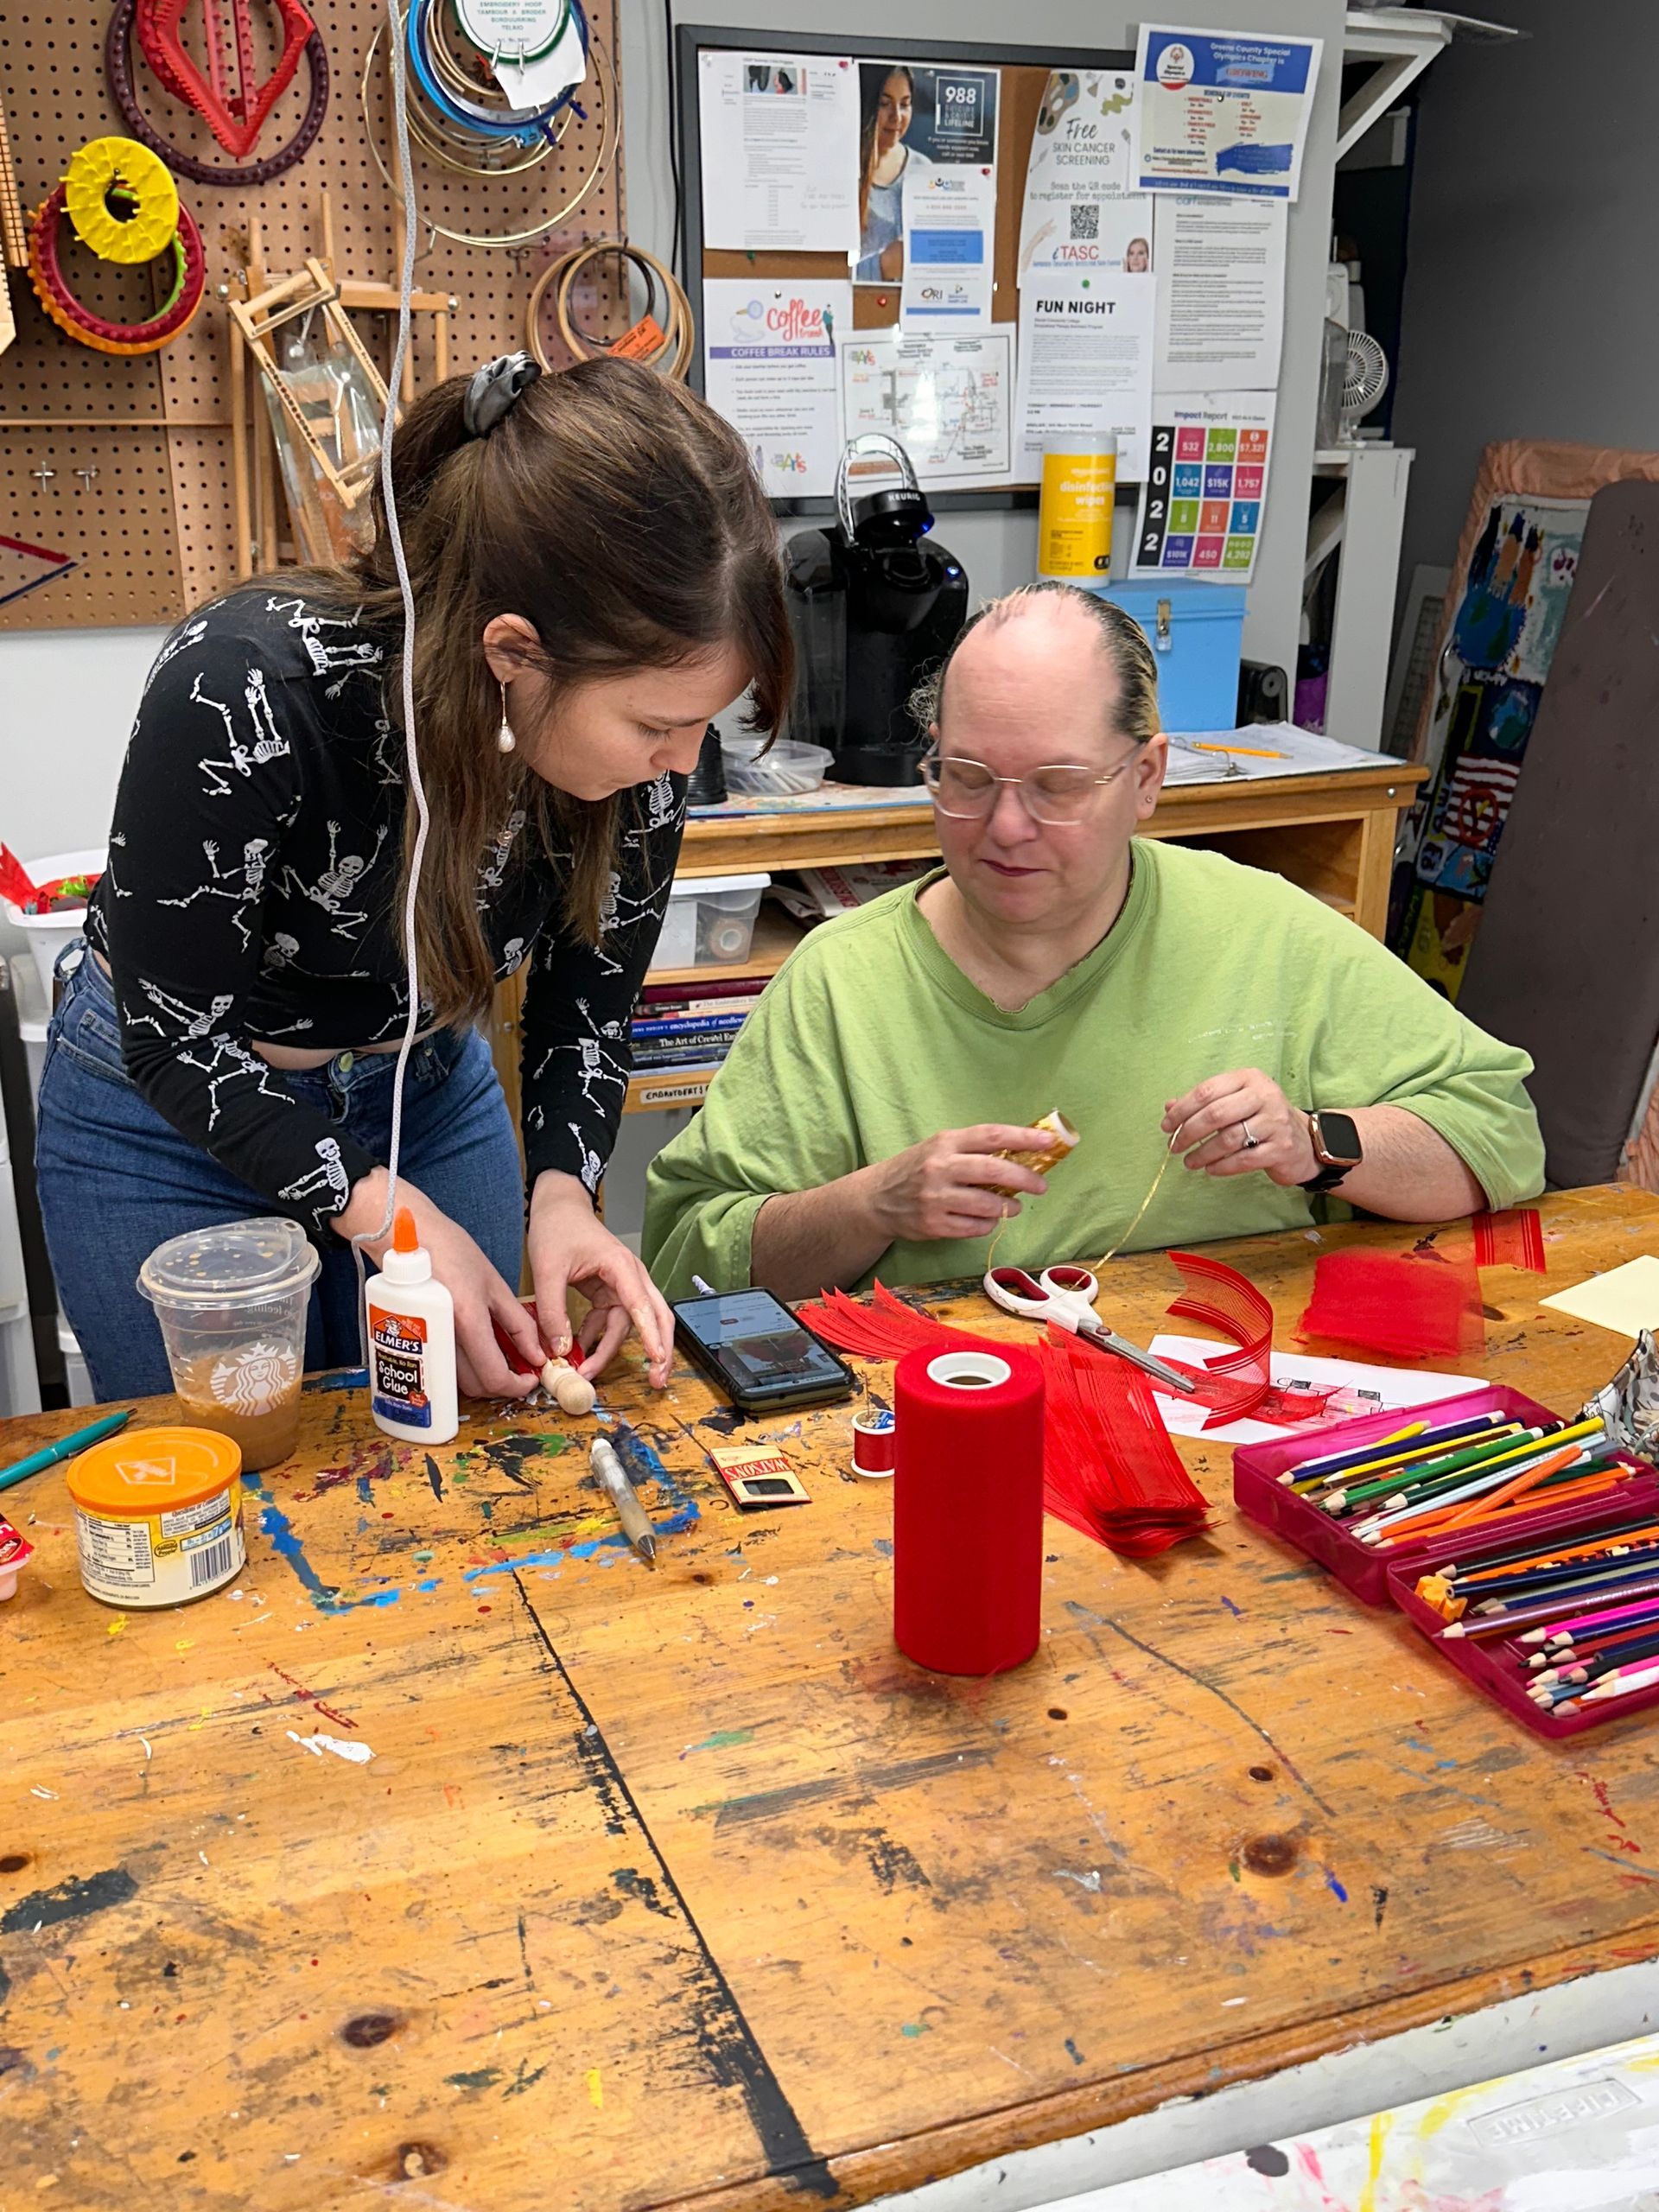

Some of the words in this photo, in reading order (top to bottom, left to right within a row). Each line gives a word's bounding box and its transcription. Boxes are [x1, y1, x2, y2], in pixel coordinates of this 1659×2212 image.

[945, 86, 976, 104] 988
[944, 118, 975, 128] LIFELINE
[1066, 118, 1098, 140] Free
[1052, 143, 1071, 152] SKIN
[1073, 143, 1116, 153] CANCER
[1056, 155, 1109, 166] SCREENING
[1072, 181, 1086, 191] the
[1039, 192, 1072, 201] register
[1076, 192, 1091, 200] for
[1036, 300, 1064, 313] FUN
[1068, 302, 1116, 315] NIGHT
[731, 347, 766, 357] COFFEE
[767, 347, 798, 357] BREAK
[800, 346, 830, 356] RULES
[1174, 410, 1202, 421] Impact
[1203, 412, 1228, 422] Report
[1208, 443, 1234, 453] 2,800
[1175, 479, 1199, 489] 1,042
[1207, 479, 1229, 489] $15K
[888, 493, 921, 503] KEURIG
[1076, 496, 1104, 508] wipes
[1242, 515, 1248, 524] 5
[1198, 550, 1217, 560] 450
[670, 1018, 709, 1031] encyclopedia
[711, 1018, 718, 1028] of
[659, 1037, 674, 1047] The
[675, 1036, 689, 1046] Art
[689, 1036, 696, 1045] of
[375, 1332, 420, 1351] ELMER'S
[378, 1362, 418, 1384] School
[383, 1377, 409, 1395] Glue
[1490, 2089, 1621, 2140] LIFETIME
